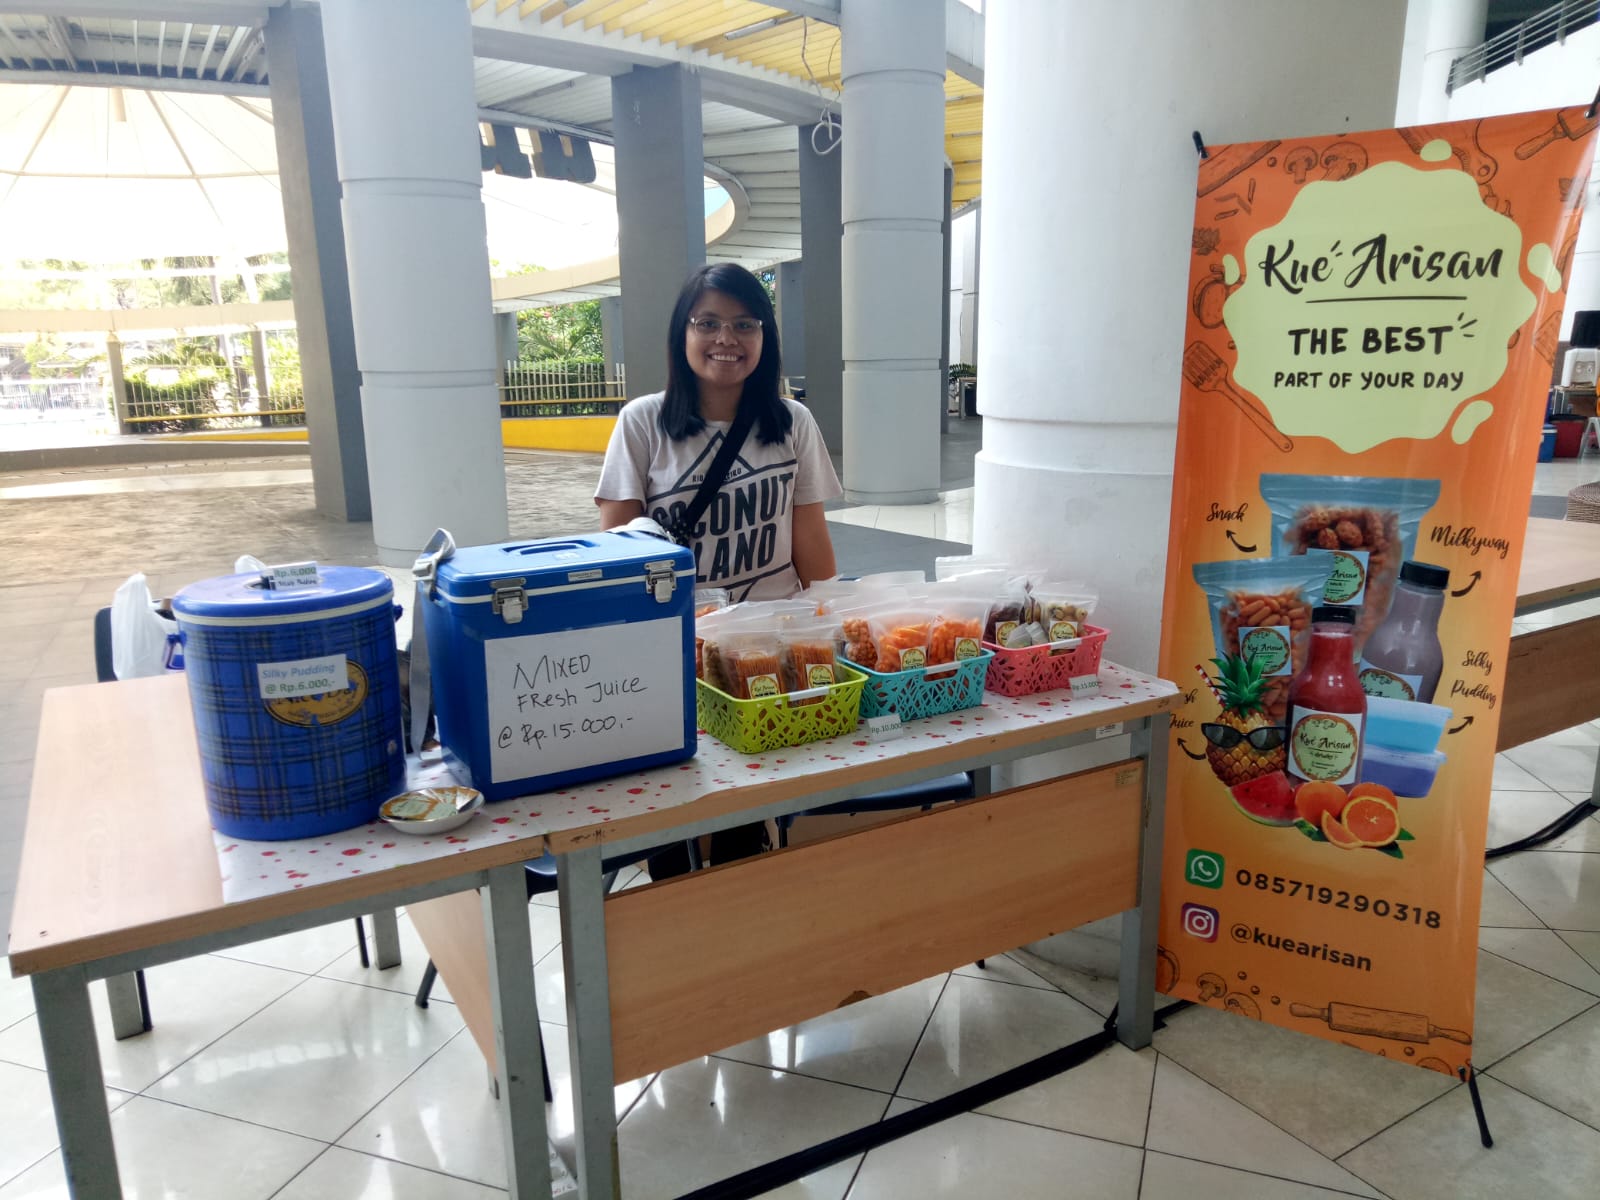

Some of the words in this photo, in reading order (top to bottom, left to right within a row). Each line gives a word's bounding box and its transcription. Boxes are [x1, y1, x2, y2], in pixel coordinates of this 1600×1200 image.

[1344, 233, 1503, 288] Arisan
[1288, 327, 1348, 355] THE
[1362, 325, 1453, 355] BEST
[1274, 371, 1323, 388] PART
[1329, 371, 1352, 388] OF
[1361, 371, 1414, 388] YOUR
[1423, 371, 1464, 391] DAY
[1206, 502, 1249, 522] Snack
[1430, 525, 1510, 559] Milkyway
[263, 669, 288, 679] Silky
[291, 664, 335, 677] Pudding
[513, 654, 591, 690] MIXED
[1462, 650, 1493, 676] Silky
[265, 684, 276, 694] @
[1451, 680, 1497, 709] Pudding
[497, 726, 512, 749] @
[1235, 868, 1442, 930] 085719290318
[1230, 922, 1373, 972] @kuearisan
